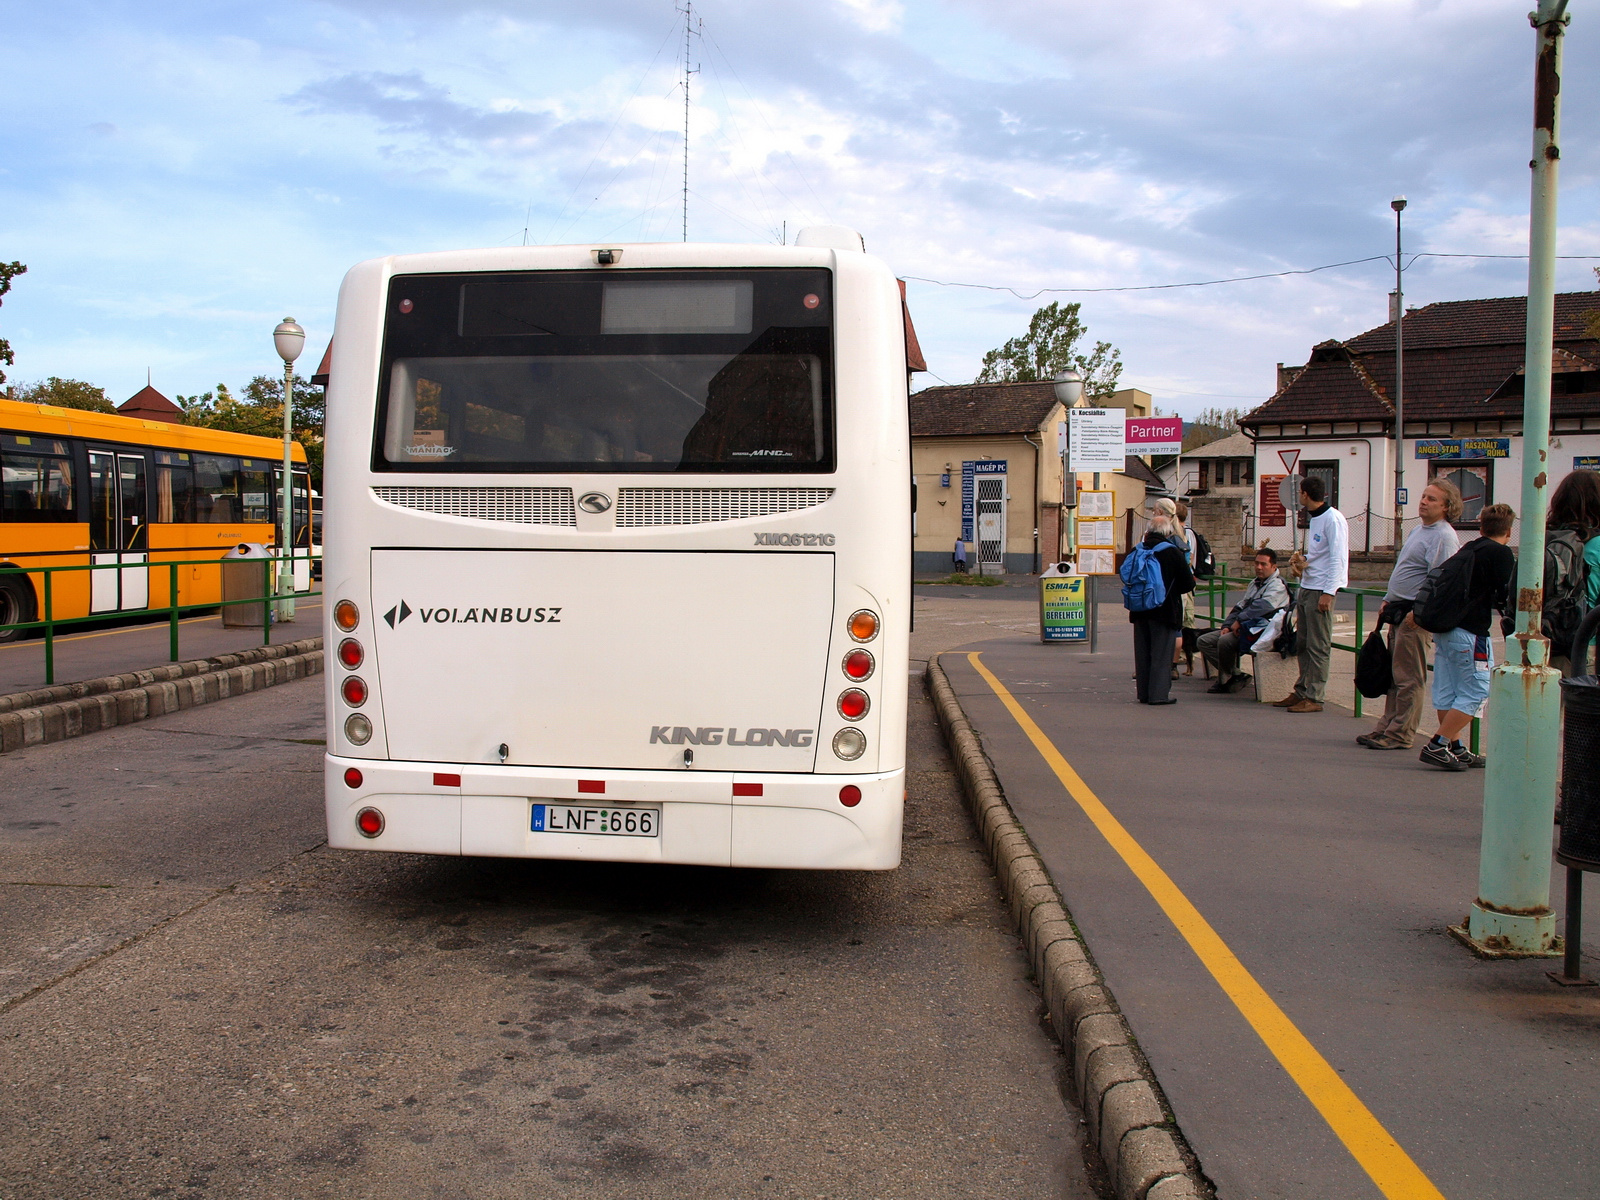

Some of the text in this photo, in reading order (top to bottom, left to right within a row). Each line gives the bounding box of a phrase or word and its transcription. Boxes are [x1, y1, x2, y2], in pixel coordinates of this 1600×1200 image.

[1130, 425, 1176, 438] Partner
[1464, 440, 1498, 449] HASZNÁLT
[409, 446, 450, 454] MANIAC
[1417, 445, 1460, 454] ANGEL STAR
[1486, 449, 1506, 457] RUHA
[976, 462, 1006, 472] MAGÉP PC
[753, 532, 836, 547] XMQ6121G
[649, 726, 814, 748] KING LONG
[535, 819, 542, 828] H
